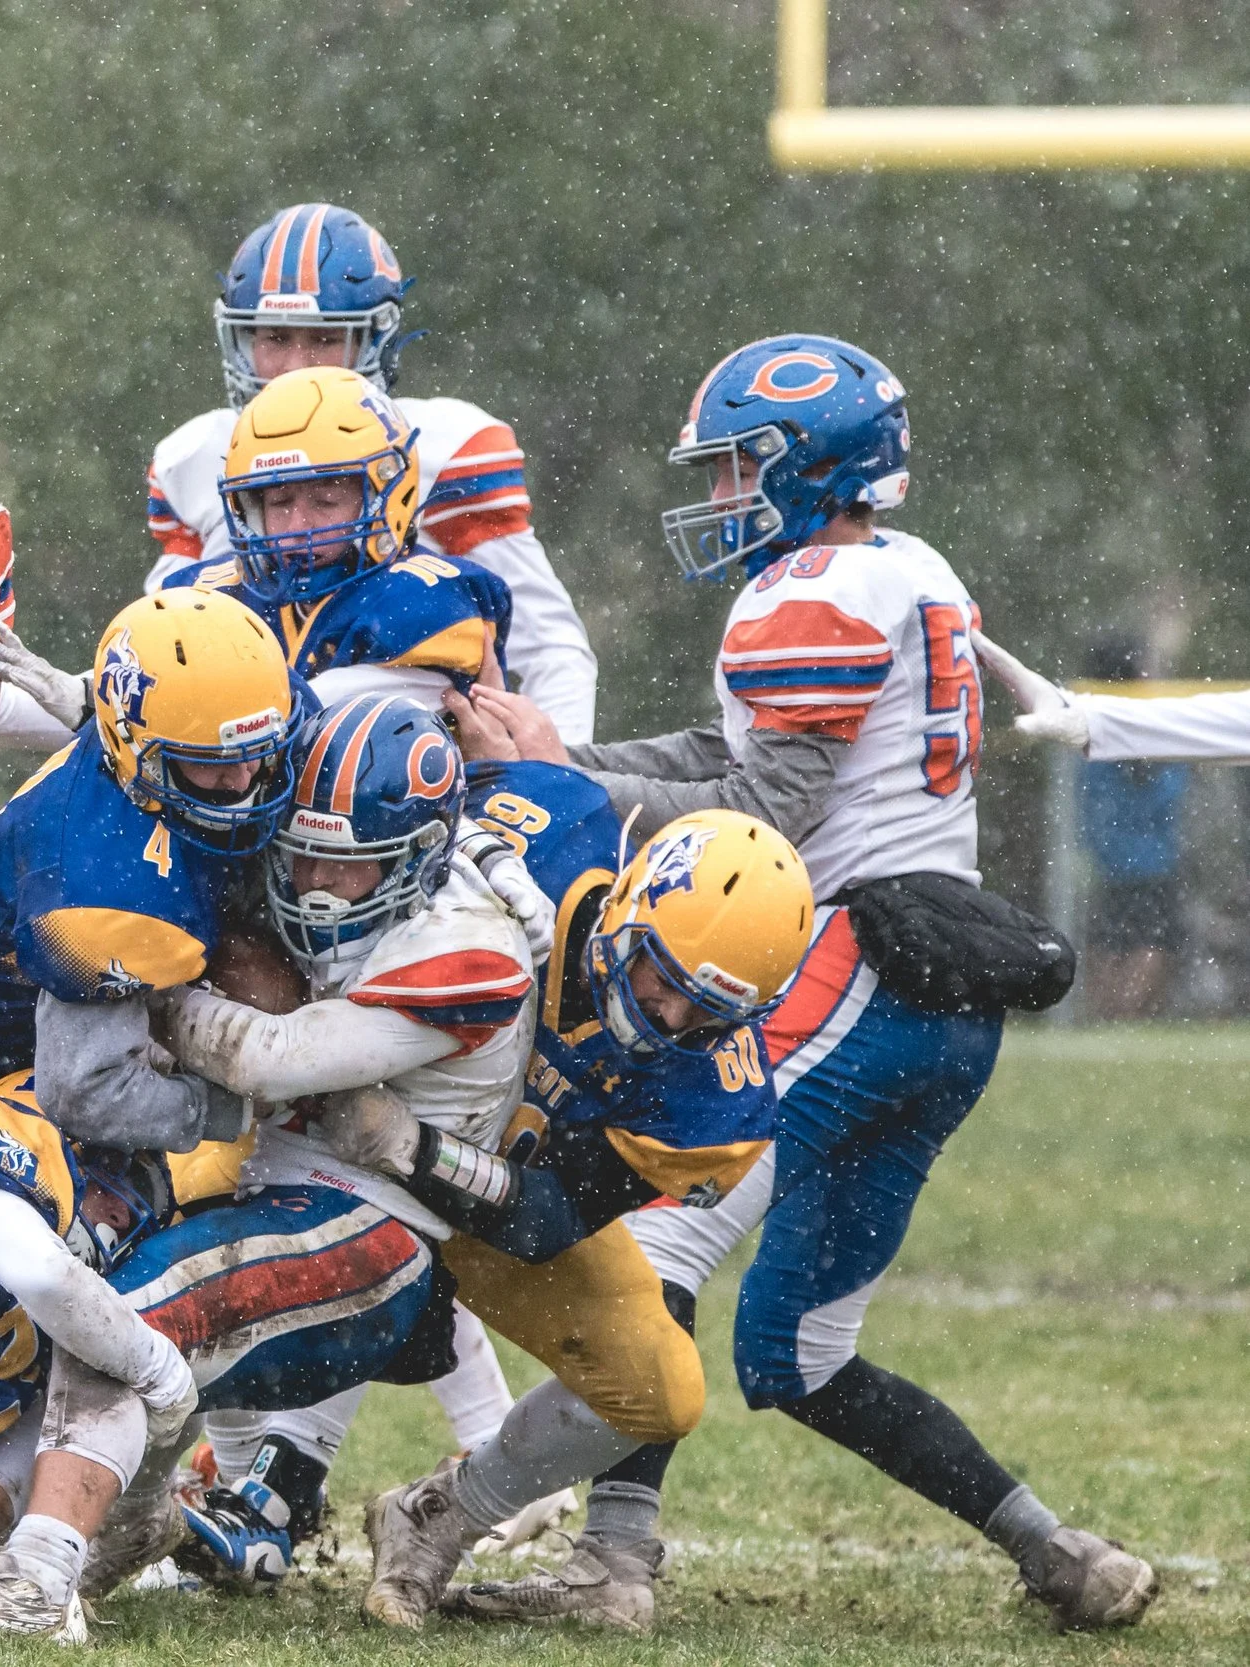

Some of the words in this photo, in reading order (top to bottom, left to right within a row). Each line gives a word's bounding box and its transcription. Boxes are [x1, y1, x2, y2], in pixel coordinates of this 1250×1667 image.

[745, 352, 839, 402] C
[255, 454, 300, 469] Riddell
[389, 554, 461, 588] 10
[918, 601, 983, 799] 5
[236, 714, 270, 735] Riddell
[404, 732, 456, 800] C
[297, 813, 343, 832] Riddell
[143, 819, 173, 878] 4
[712, 974, 748, 997] Riddell
[713, 1025, 765, 1093] 60
[310, 1169, 357, 1194] Riddell
